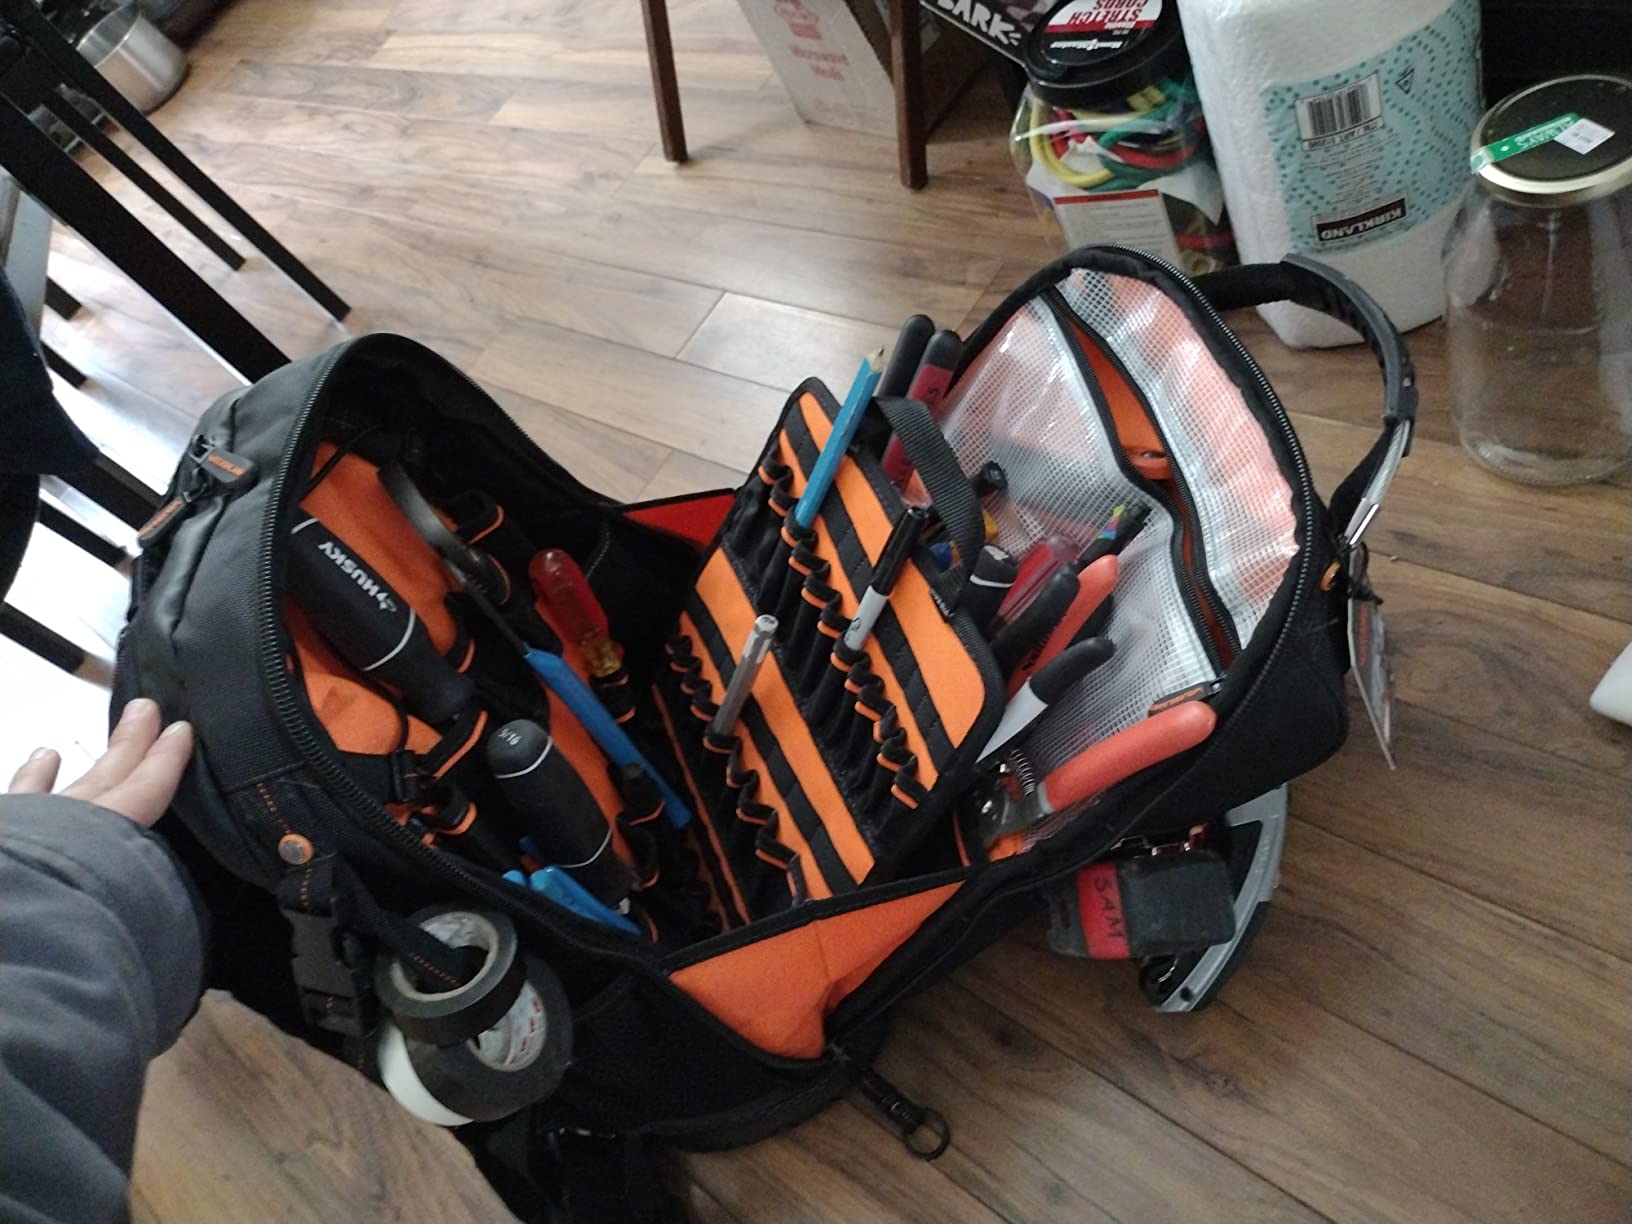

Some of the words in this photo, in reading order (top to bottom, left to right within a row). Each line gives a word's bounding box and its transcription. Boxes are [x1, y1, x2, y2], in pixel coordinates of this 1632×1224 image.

[1067, 9, 1142, 24] STRETCH
[1320, 208, 1402, 240] KIRKLAND
[318, 541, 381, 597] HUSKY
[497, 728, 522, 746] 5/16
[1094, 876, 1125, 938] SAM
